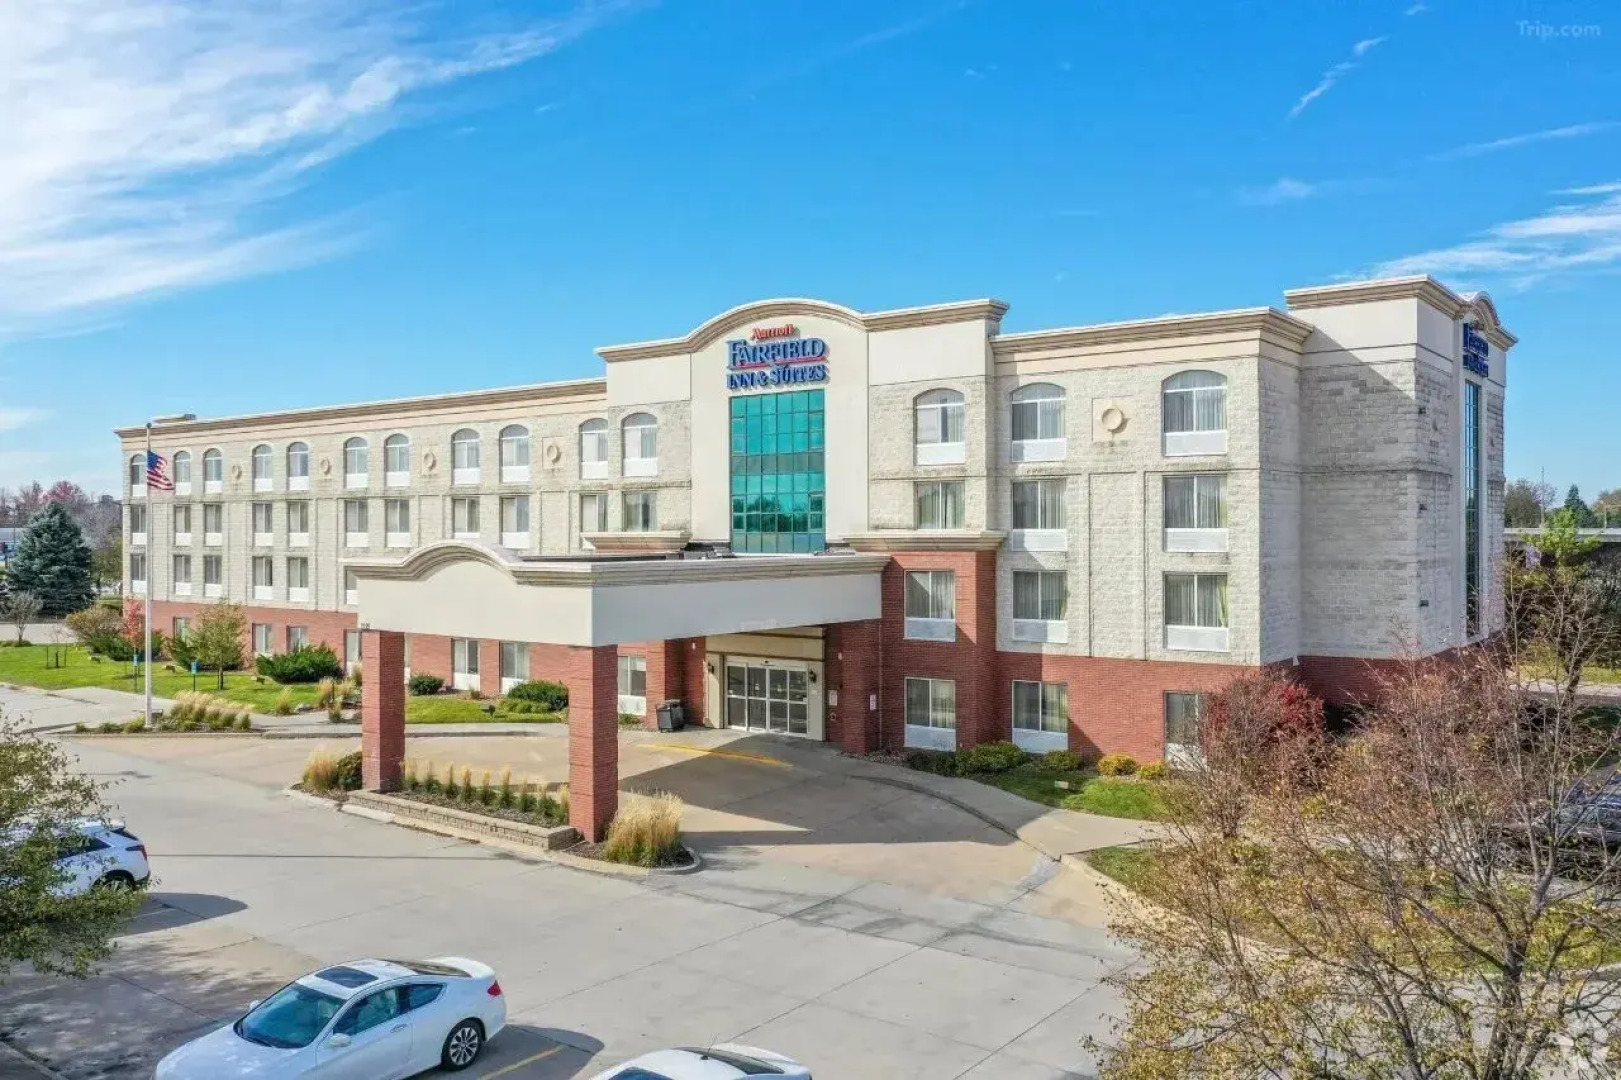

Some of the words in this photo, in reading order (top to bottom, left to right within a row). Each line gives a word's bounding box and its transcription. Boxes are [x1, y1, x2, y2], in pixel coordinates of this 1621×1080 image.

[726, 338, 827, 370] FAIRFIELD
[727, 371, 754, 389] INN
[755, 370, 768, 387] &
[770, 364, 828, 386] SUITES
